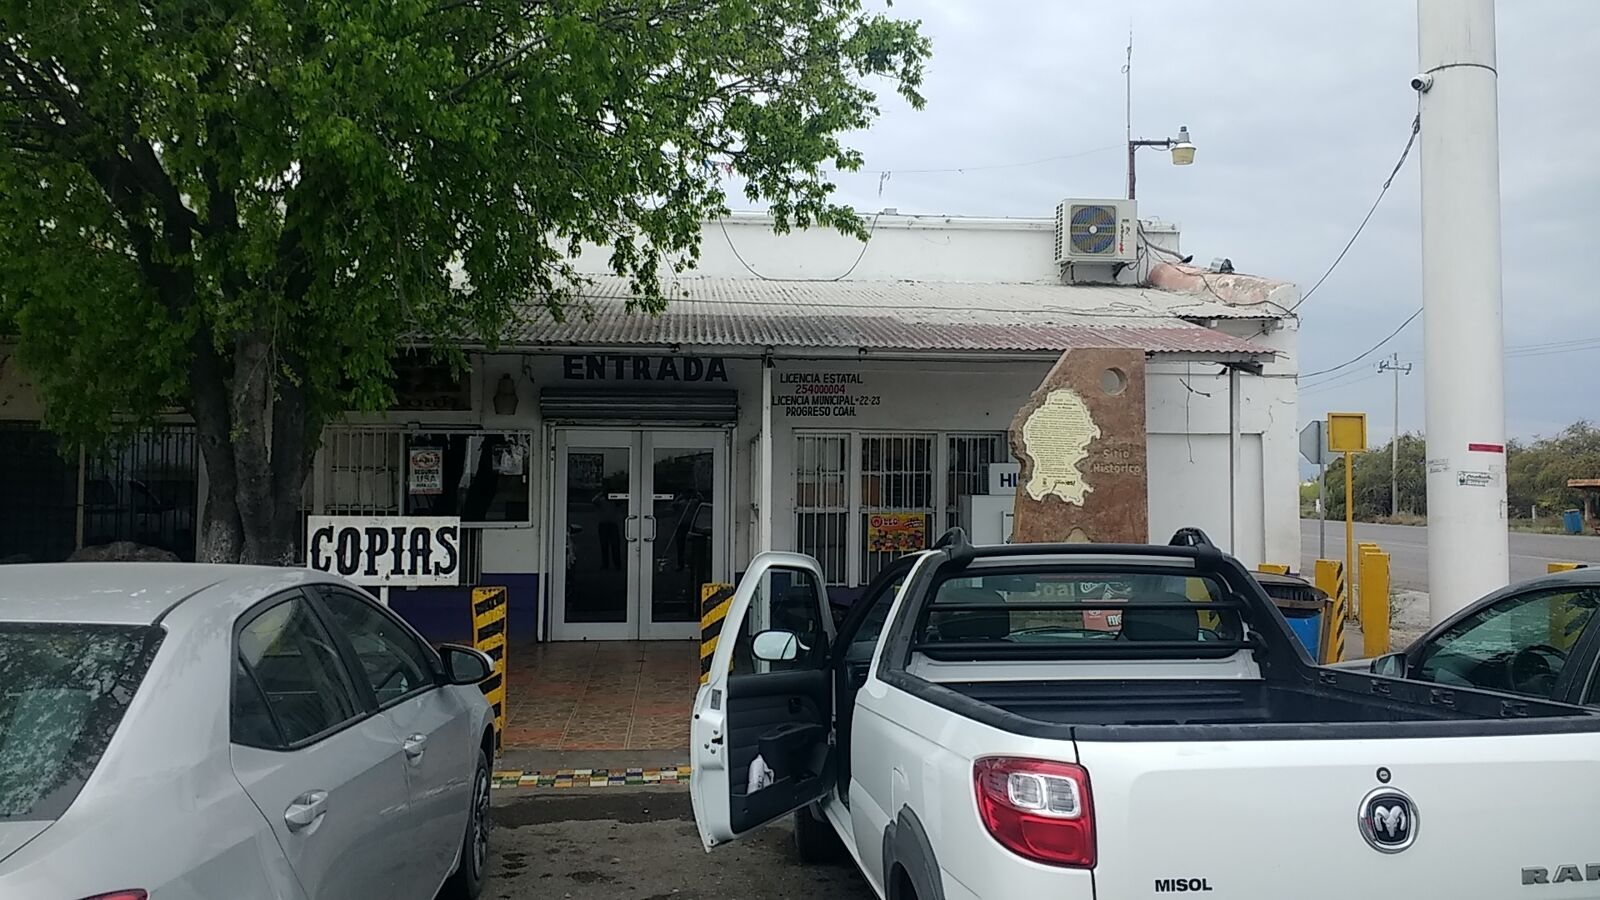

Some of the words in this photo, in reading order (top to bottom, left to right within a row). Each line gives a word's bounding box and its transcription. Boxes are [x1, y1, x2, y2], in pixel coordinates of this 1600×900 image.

[563, 355, 728, 382] ENTRADA
[780, 373, 820, 384] LICENCIA
[823, 373, 863, 384] ESTATAL
[772, 395, 810, 406] LICENCIA
[785, 406, 831, 417] PROGRESO
[416, 474, 438, 483] USA
[1000, 472, 1020, 488] HI
[310, 525, 458, 576] COPIAS
[1155, 878, 1213, 892] MISOL
